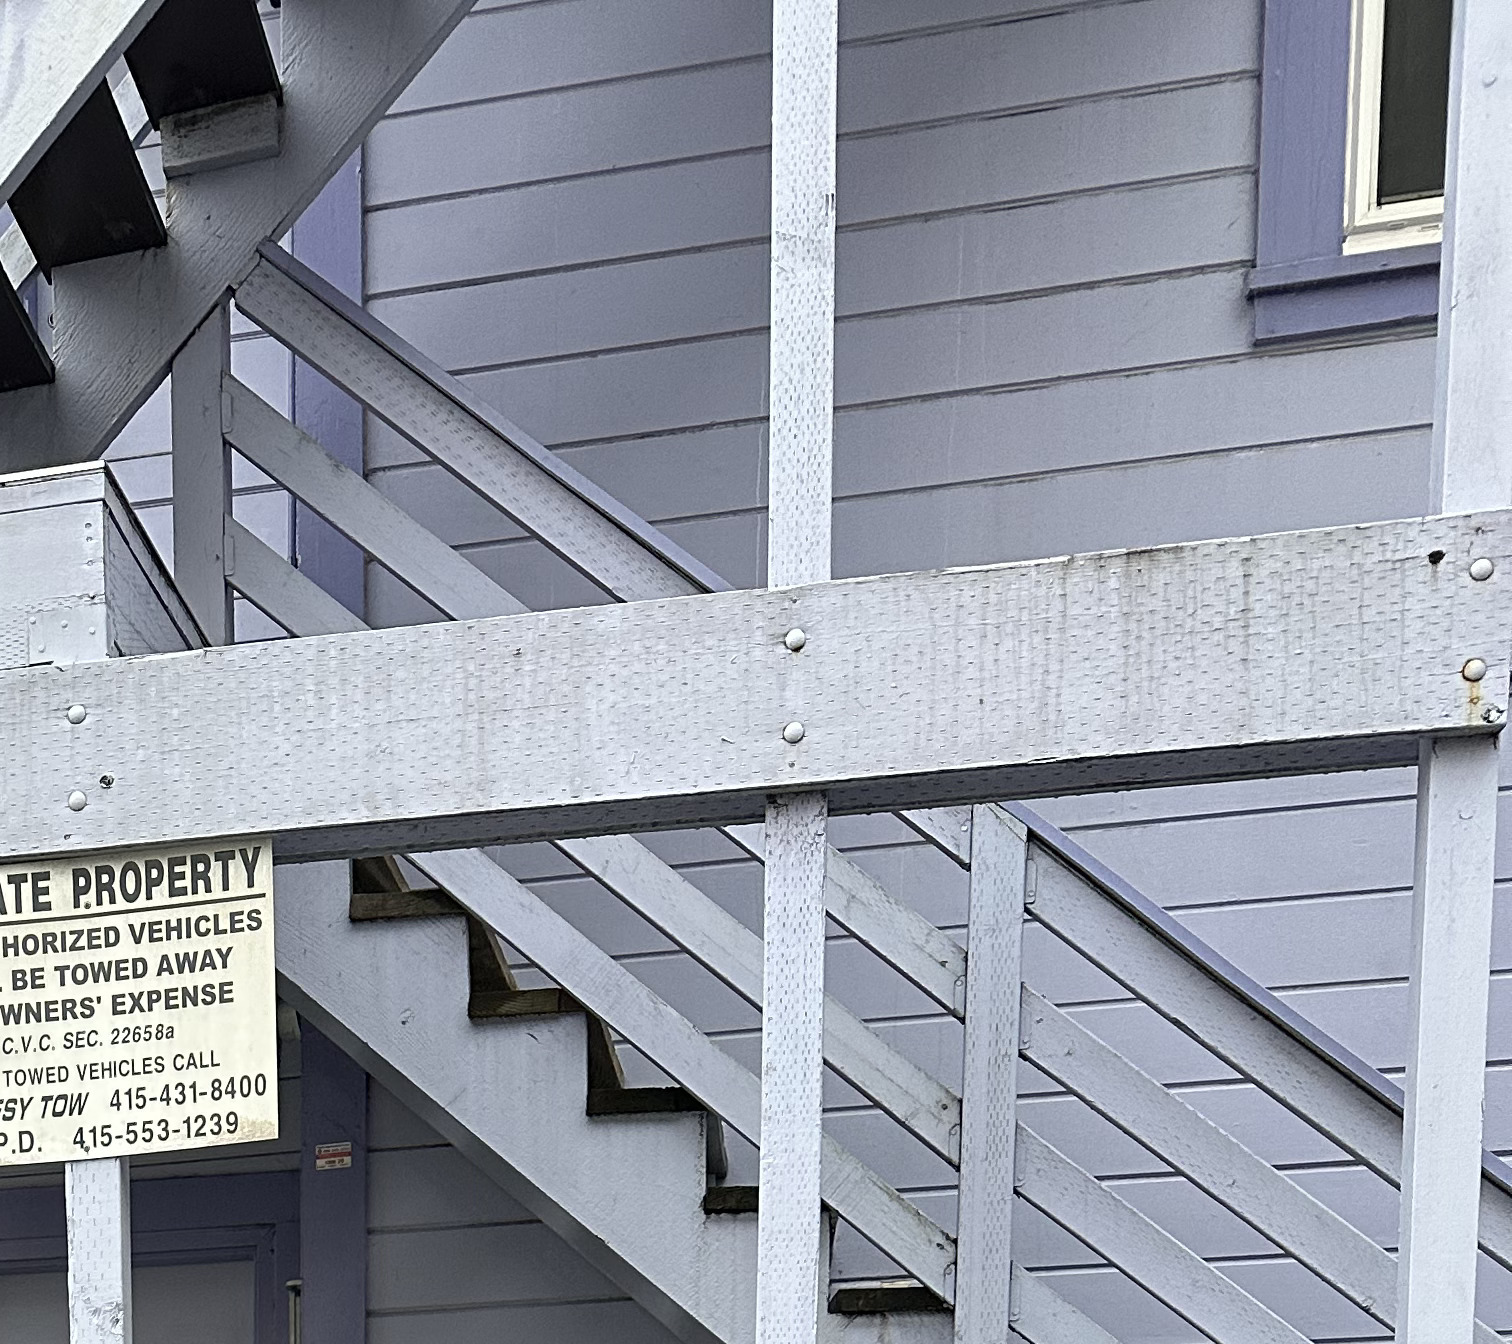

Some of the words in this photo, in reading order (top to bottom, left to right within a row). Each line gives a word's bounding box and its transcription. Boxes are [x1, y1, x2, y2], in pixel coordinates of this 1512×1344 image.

[71, 845, 262, 910] PROPERTY
[127, 908, 263, 945] VEHICLES
[11, 966, 46, 992] BE
[53, 956, 148, 987] TOWED
[155, 946, 234, 977] AWAY
[111, 980, 234, 1016] EXPENSE
[2, 1033, 56, 1055] C.V.C.
[62, 1029, 103, 1050] SEC.
[110, 1023, 175, 1046] 22658a
[2, 1065, 69, 1088] TOWED
[75, 1055, 165, 1082] VEHICLES
[172, 1049, 221, 1072] CALL
[40, 1091, 90, 1119] TOW
[109, 1072, 267, 1112] 415-431-8400
[72, 1111, 239, 1154] 415-553-1239
